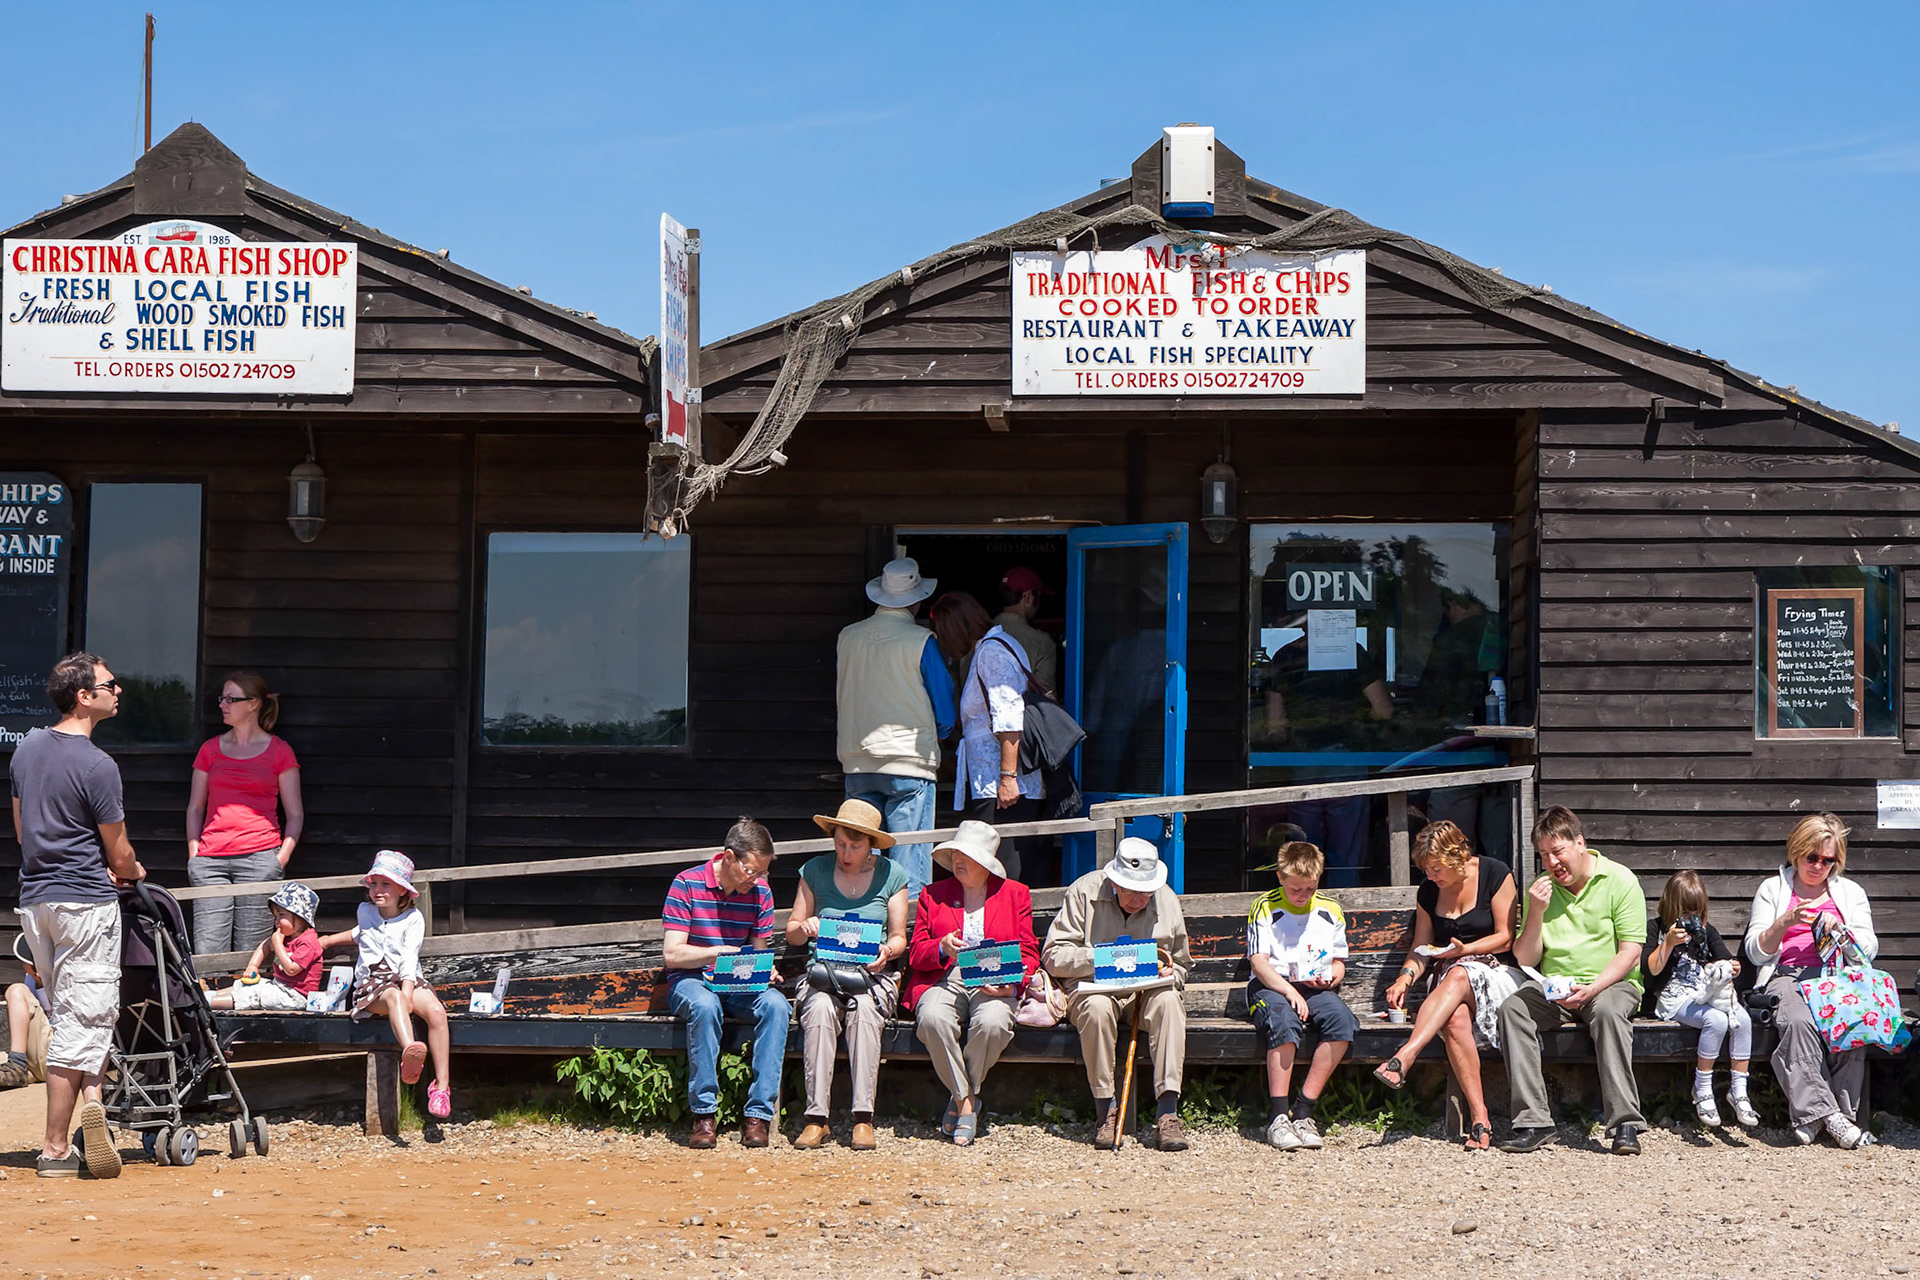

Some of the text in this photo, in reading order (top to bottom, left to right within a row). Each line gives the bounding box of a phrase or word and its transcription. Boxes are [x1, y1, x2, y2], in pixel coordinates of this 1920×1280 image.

[124, 234, 143, 245] EST.
[209, 235, 231, 245] 1985
[12, 246, 348, 276] CHRISTINA CARA FISH SHOP
[44, 278, 311, 303] FRESH LOCAL FISH
[1028, 272, 1350, 296] TRADITIONAL FISH & CHIPS
[9, 291, 345, 328] Traditional WOOD SMOKED FISH
[1059, 298, 1319, 317] COOKED TO ORDER
[1023, 319, 1356, 338] RESTAURANT & TAKEAWAY
[99, 329, 256, 352] & SHELL FISH
[1066, 347, 1314, 365] LOCAL FISH SPECIALITY
[1184, 372, 1305, 389] 01502724709
[0, 484, 62, 503] HIPS
[36, 509, 48, 524] &
[9, 558, 55, 573] INSIDE
[1288, 570, 1373, 602] OPEN
[1785, 607, 1846, 621] Frying Times
[1777, 628, 1791, 637] Mon
[1777, 659, 1794, 669] Thur
[1778, 673, 1790, 682] Fri
[1777, 686, 1789, 695] Sat
[1777, 699, 1791, 708] Sun
